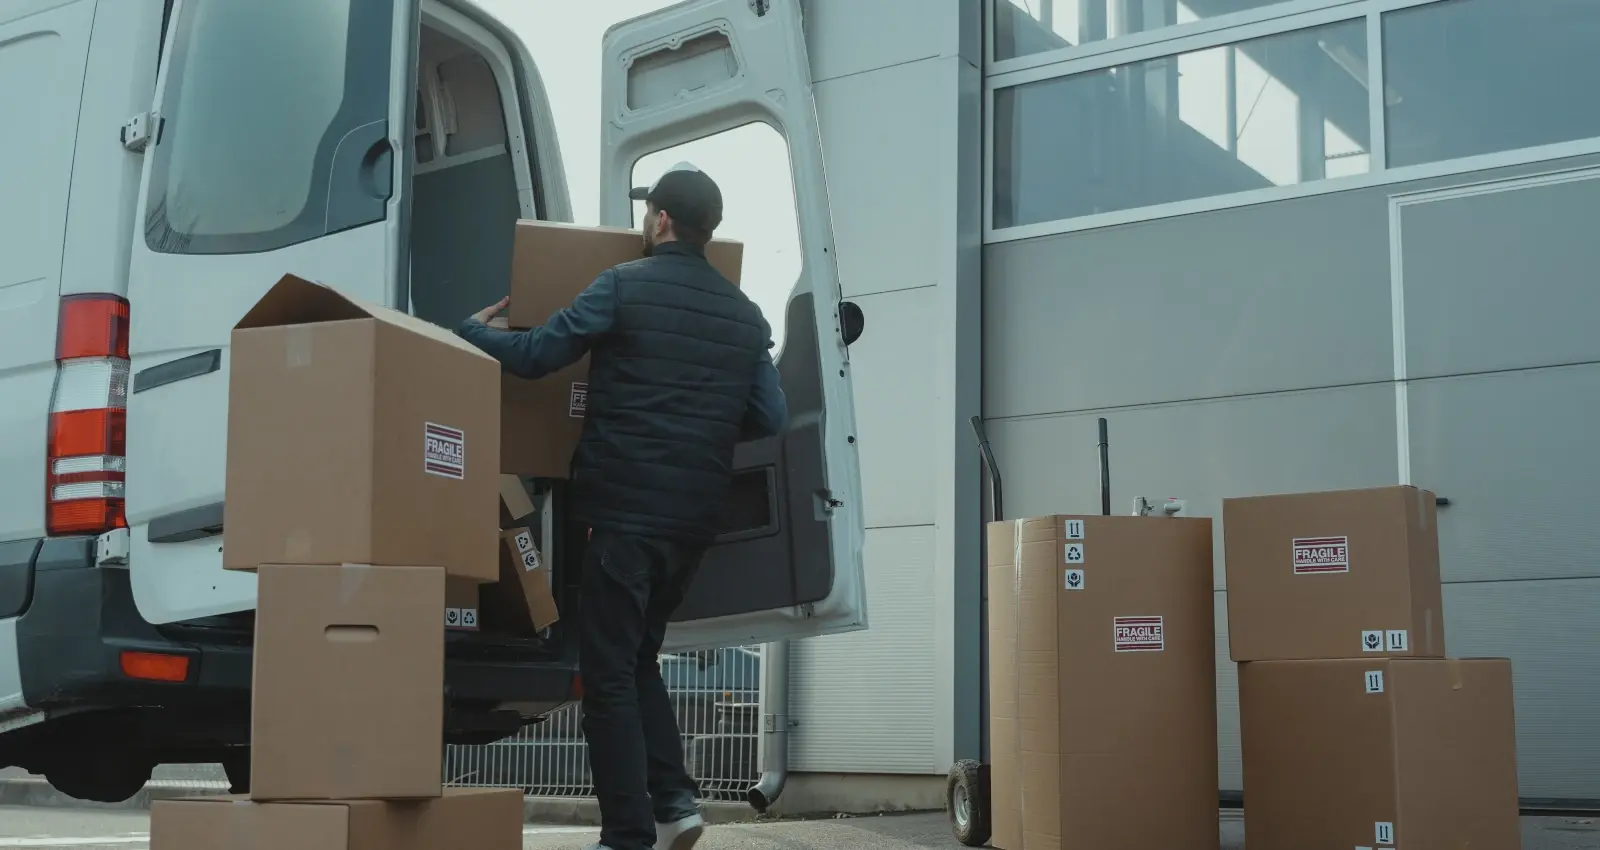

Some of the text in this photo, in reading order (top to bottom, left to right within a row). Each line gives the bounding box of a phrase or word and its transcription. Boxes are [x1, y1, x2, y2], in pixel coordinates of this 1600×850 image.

[427, 438, 462, 458] FRAGILE
[1296, 548, 1345, 559] FRAGILE
[1116, 627, 1160, 637] FRAGILE
